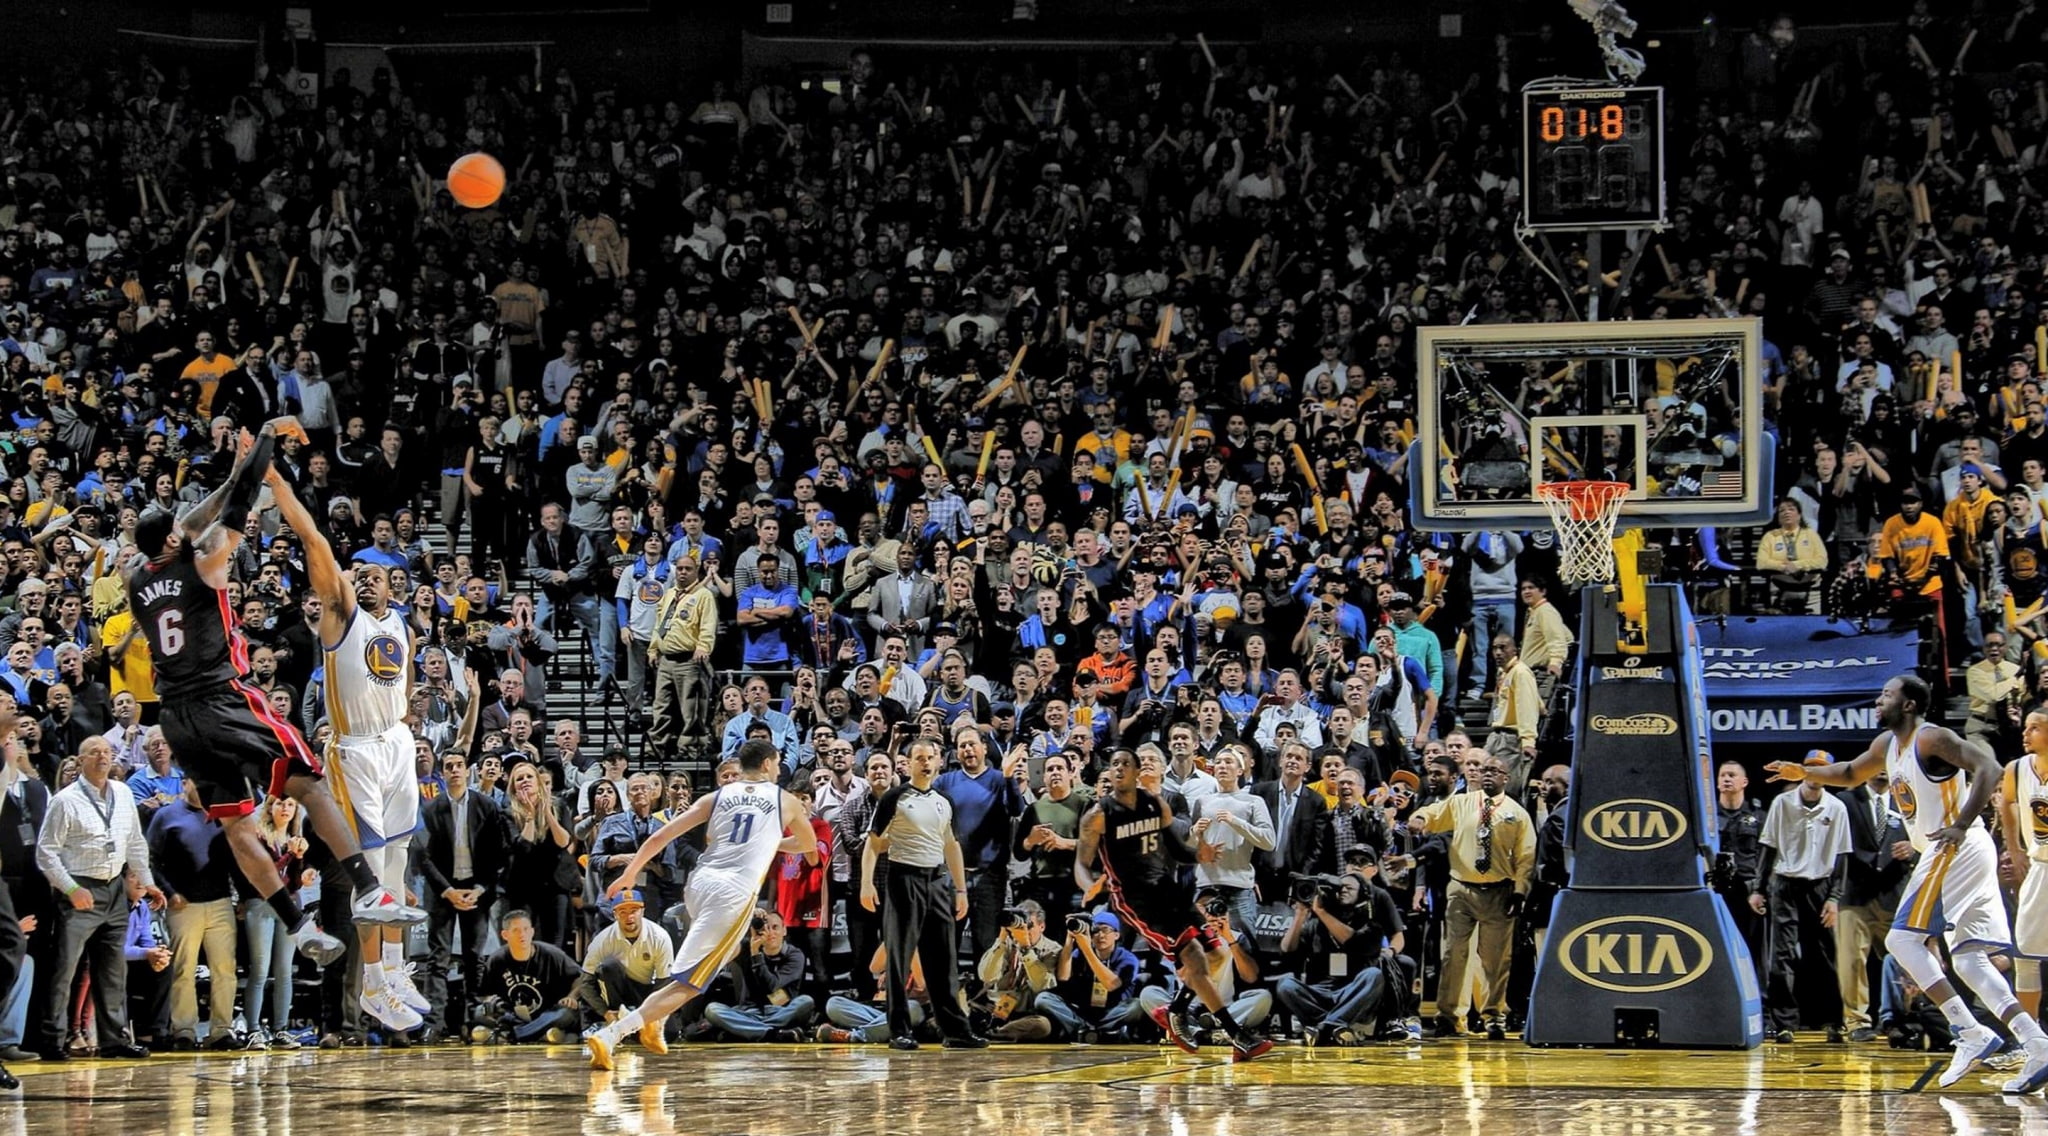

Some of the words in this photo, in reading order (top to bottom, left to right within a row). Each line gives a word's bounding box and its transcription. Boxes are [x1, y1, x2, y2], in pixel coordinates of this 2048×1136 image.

[1560, 91, 1626, 100] DAKTRONICS
[137, 580, 183, 606] JAMES
[157, 609, 186, 656] 6
[385, 643, 393, 655] 9
[1701, 648, 1765, 657] ITY
[1602, 666, 1664, 680] SPALDING
[1704, 656, 1891, 671] ATIONAL
[719, 797, 776, 816] THOMPSON
[728, 813, 755, 844] 11
[1116, 816, 1160, 840] MIAMI
[1600, 811, 1670, 838] KIA
[1139, 833, 1158, 855] 15
[1585, 933, 1688, 975] KIA
[506, 974, 540, 987] CITY
